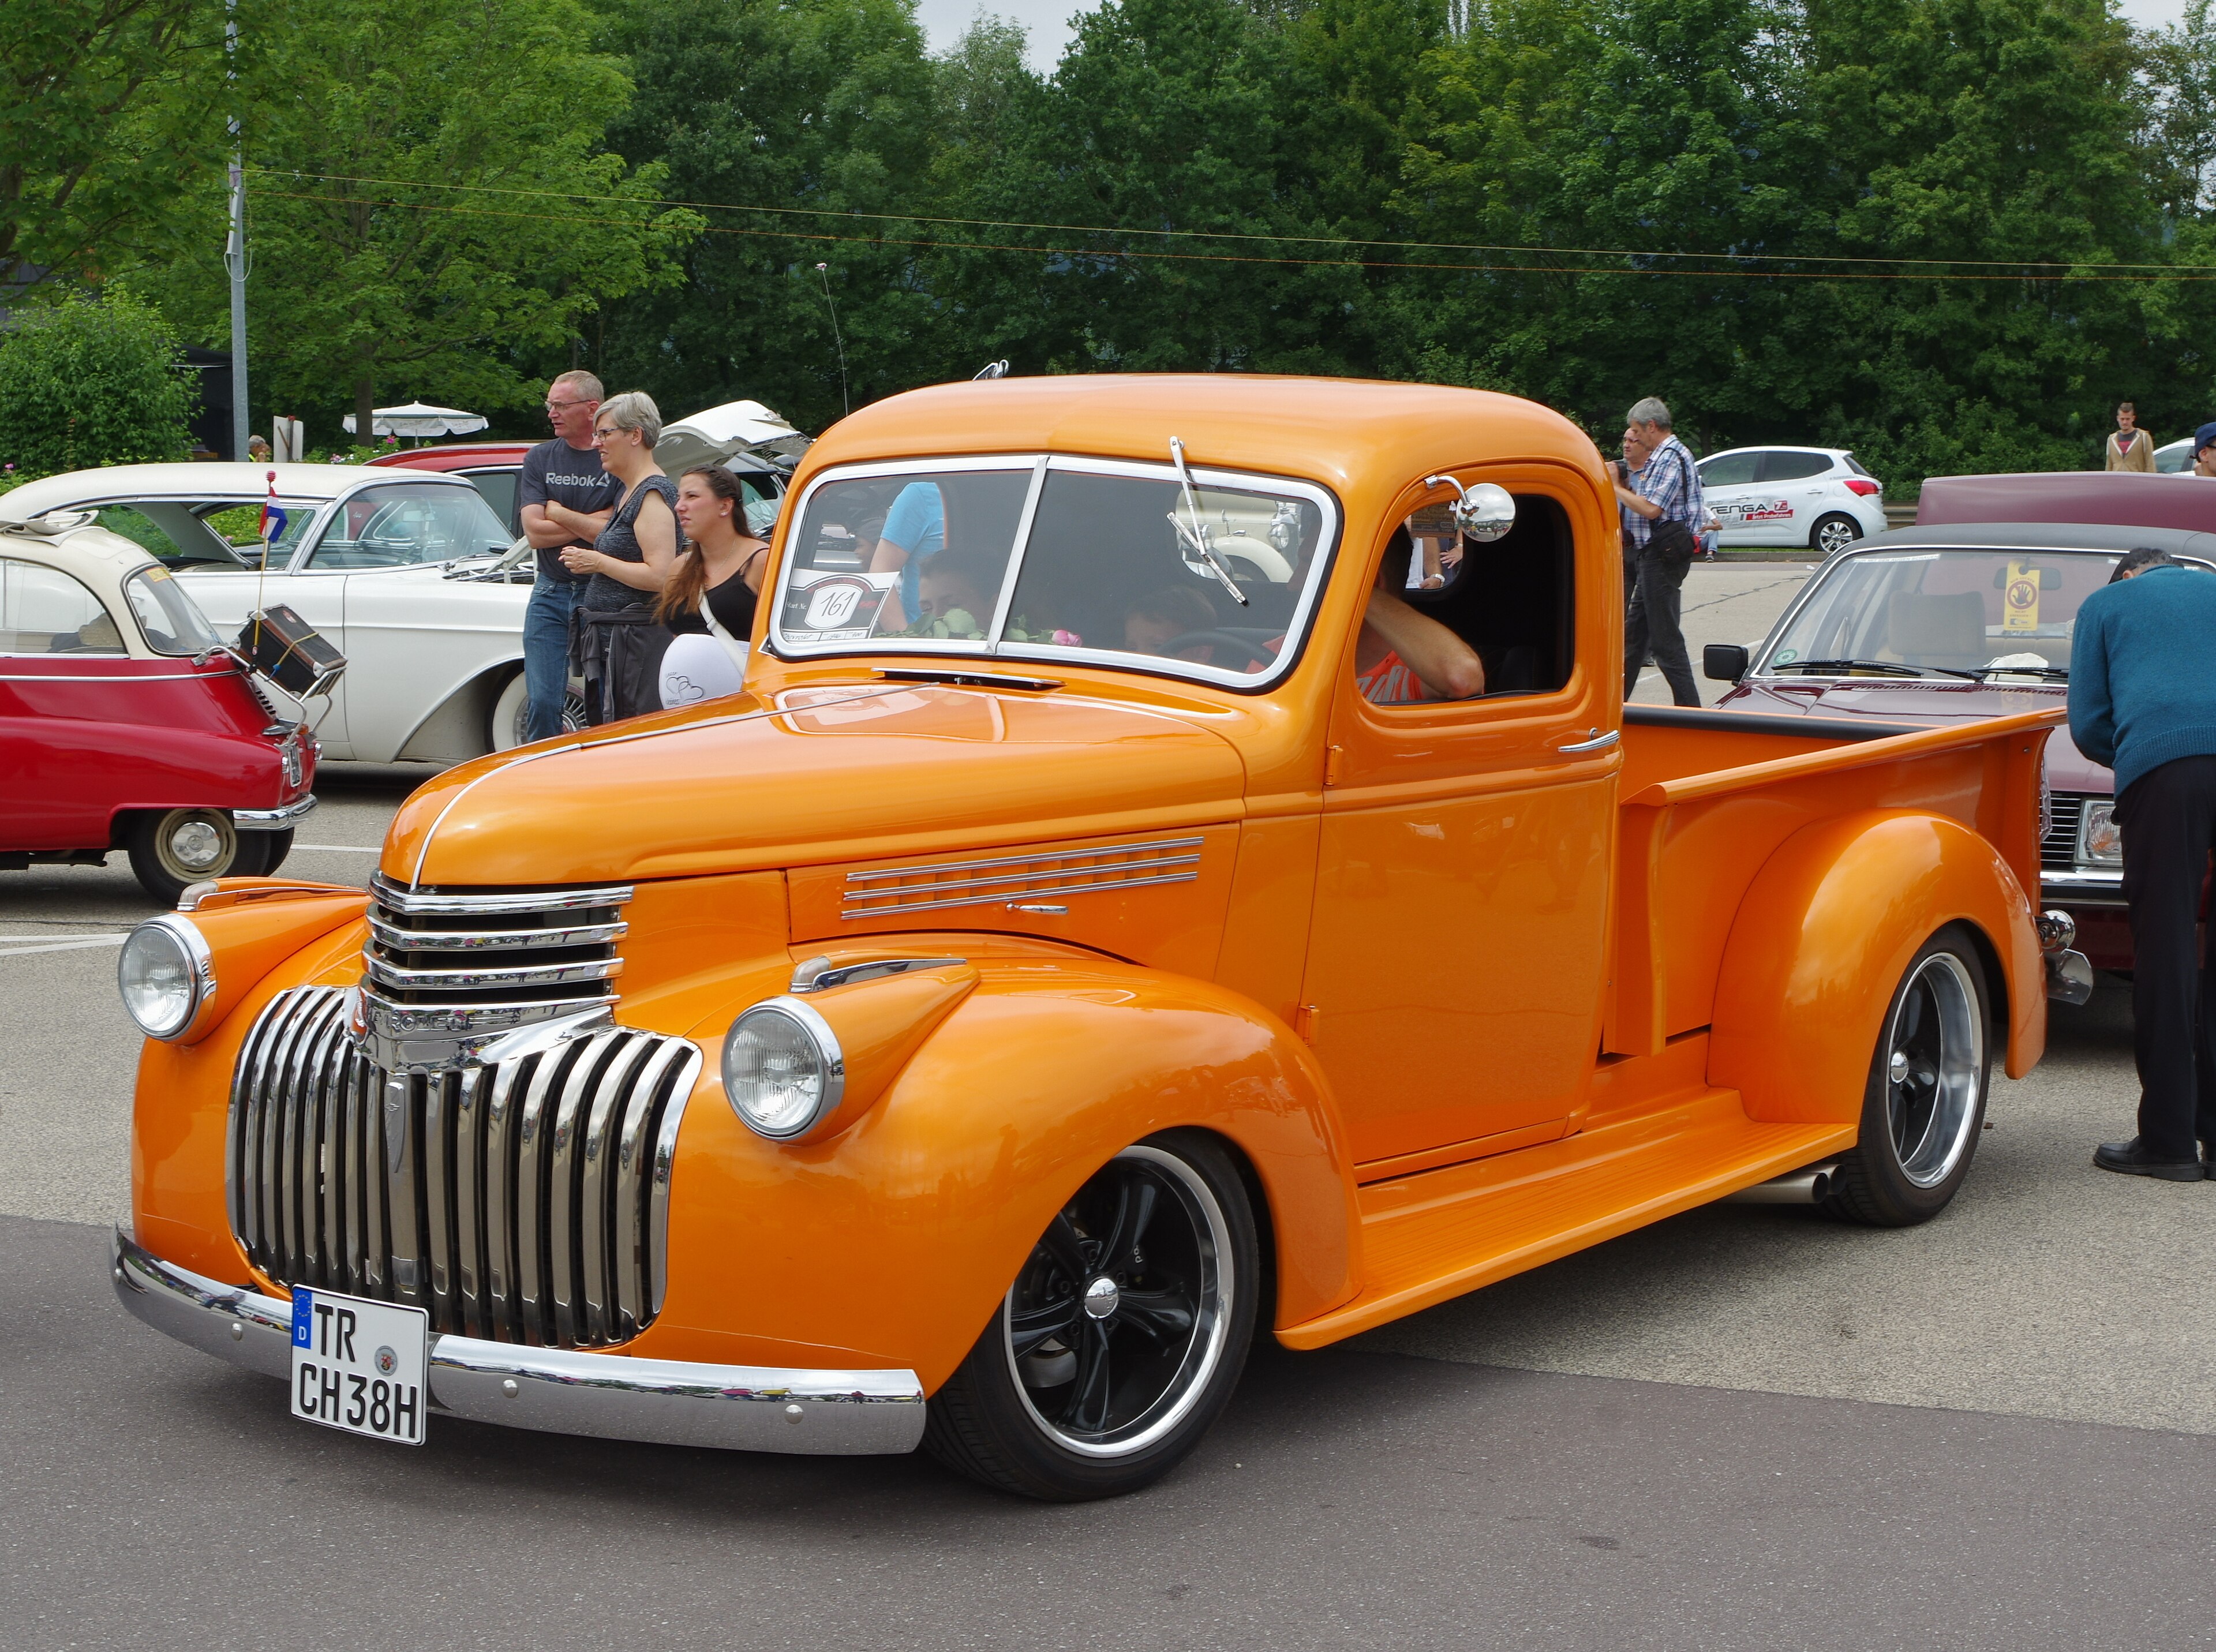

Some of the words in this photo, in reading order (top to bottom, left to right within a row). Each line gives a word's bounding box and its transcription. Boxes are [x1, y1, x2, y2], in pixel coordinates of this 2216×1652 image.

[545, 472, 596, 487] Reebok
[820, 591, 855, 617] 161
[298, 1325, 307, 1341] D
[315, 1303, 356, 1362] TR
